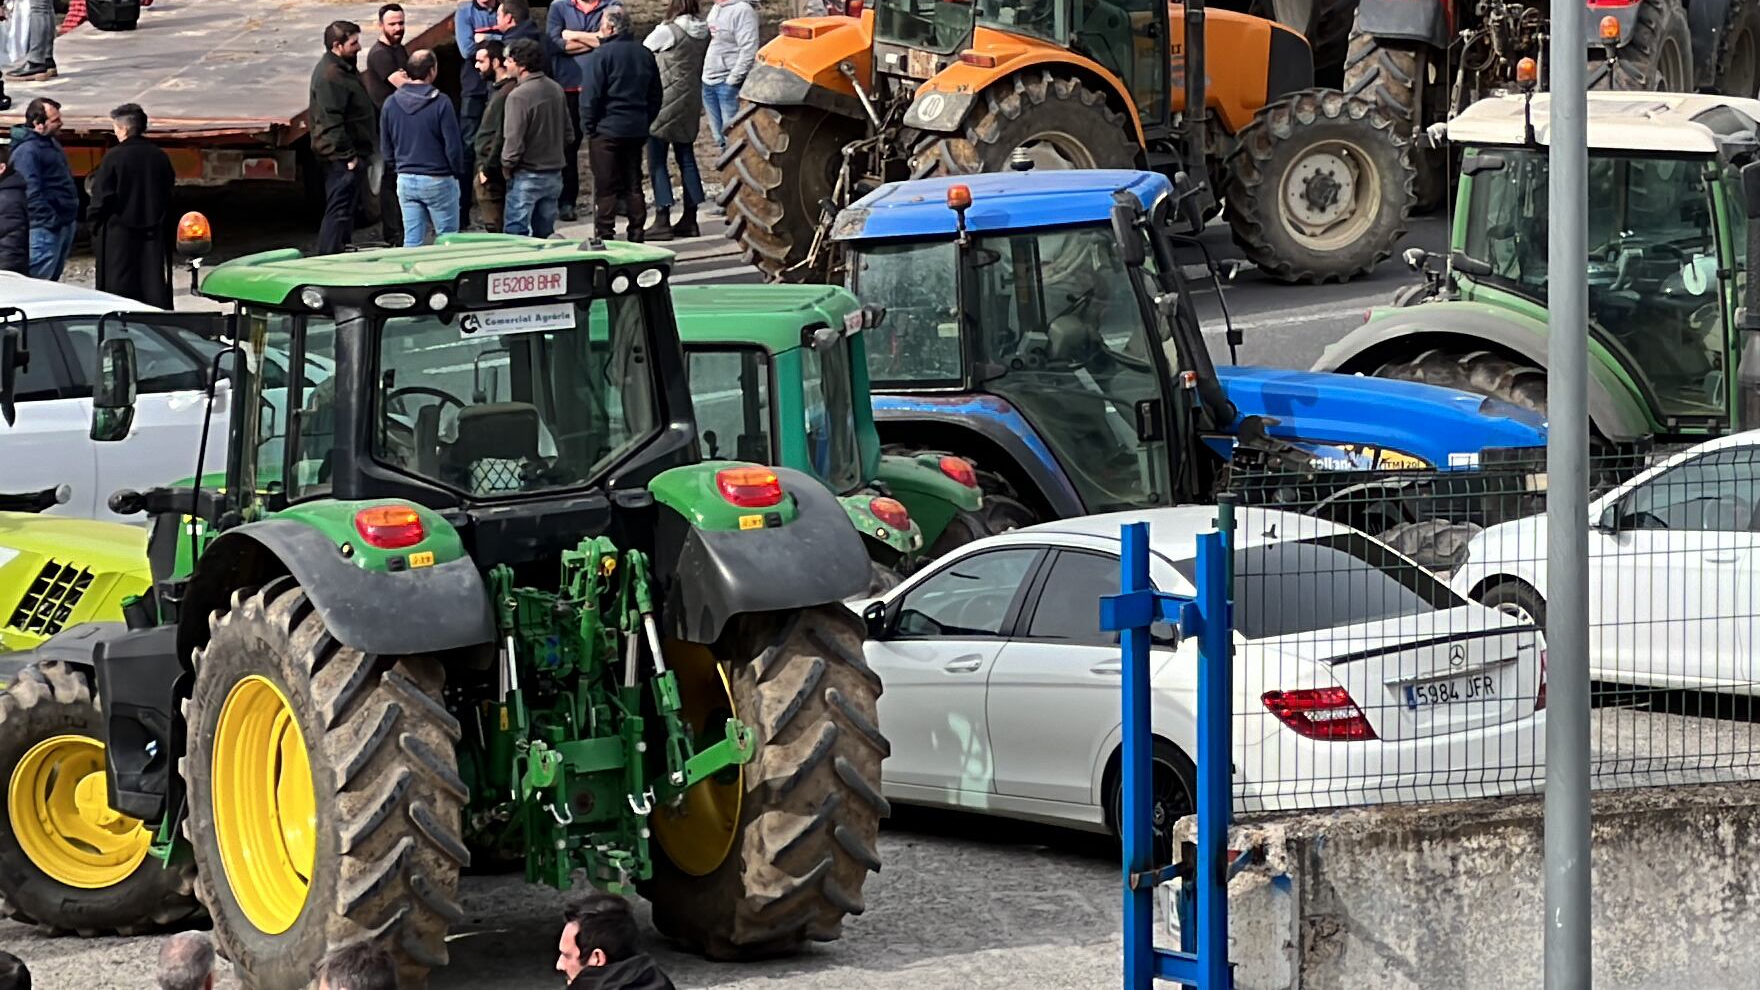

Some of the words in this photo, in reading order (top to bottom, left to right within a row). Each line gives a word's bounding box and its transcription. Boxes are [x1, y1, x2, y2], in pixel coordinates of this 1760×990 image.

[922, 97, 941, 117] 40
[537, 273, 562, 291] BHR
[485, 314, 531, 326] Comercial
[1416, 682, 1459, 704] 5984
[1466, 676, 1495, 698] JFR
